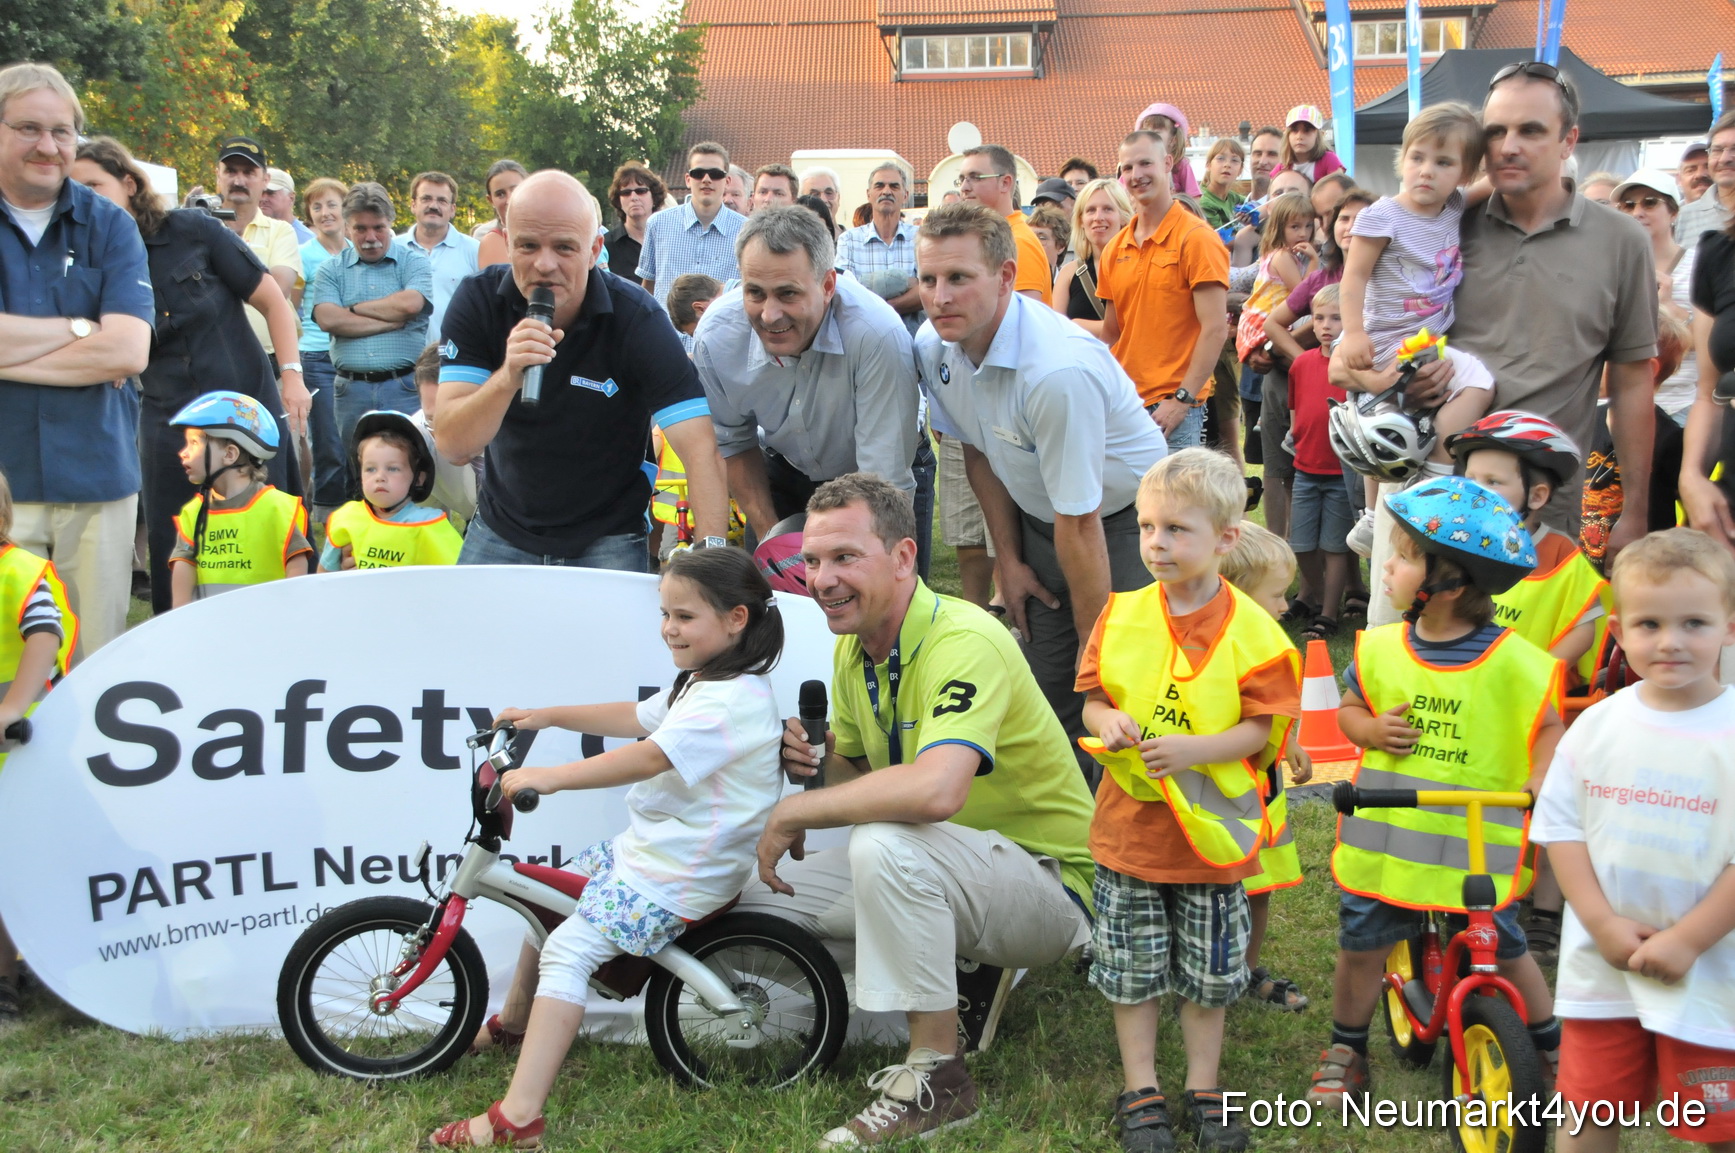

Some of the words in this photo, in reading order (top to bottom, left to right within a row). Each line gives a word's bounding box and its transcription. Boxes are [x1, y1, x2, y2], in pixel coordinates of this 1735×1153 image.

[209, 528, 239, 542] BMW
[201, 543, 244, 555] PARTL
[367, 547, 405, 563] BMW
[199, 559, 253, 570] eumarkt
[1494, 603, 1522, 623] MW
[933, 679, 977, 718] 3
[1412, 694, 1462, 715] BMW
[1406, 714, 1462, 740] PARTL
[1411, 742, 1468, 765] umarkt
[88, 851, 299, 922] PARTL
[1677, 1066, 1735, 1087] LONGBA
[1701, 1083, 1728, 1098] 1962
